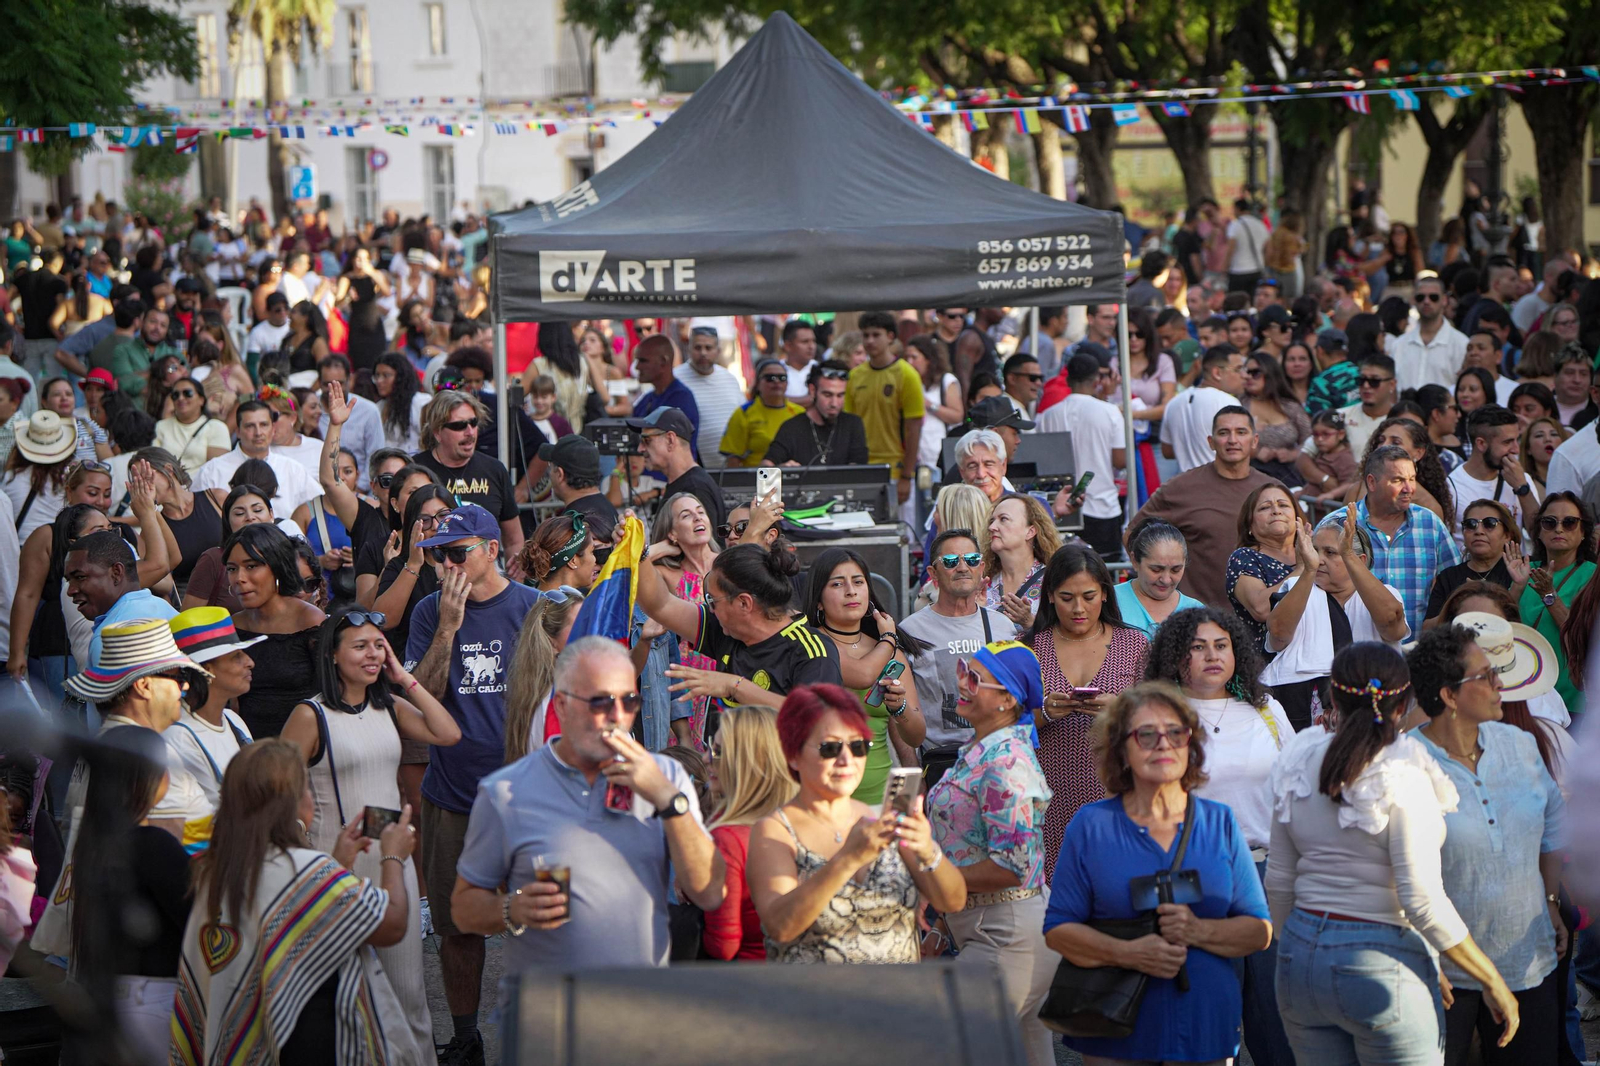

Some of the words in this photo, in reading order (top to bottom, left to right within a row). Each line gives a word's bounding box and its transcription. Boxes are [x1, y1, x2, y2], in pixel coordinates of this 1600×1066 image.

[978, 240, 1014, 254] 856
[1017, 237, 1052, 252] 057
[1056, 234, 1091, 250] 522
[978, 258, 1012, 274] 657
[1015, 256, 1052, 272] 869
[1056, 254, 1094, 270] 934
[978, 276, 1093, 289] www.d-arte.org
[590, 294, 698, 303] AUDIOVISUALES
[458, 687, 477, 695] QUE
